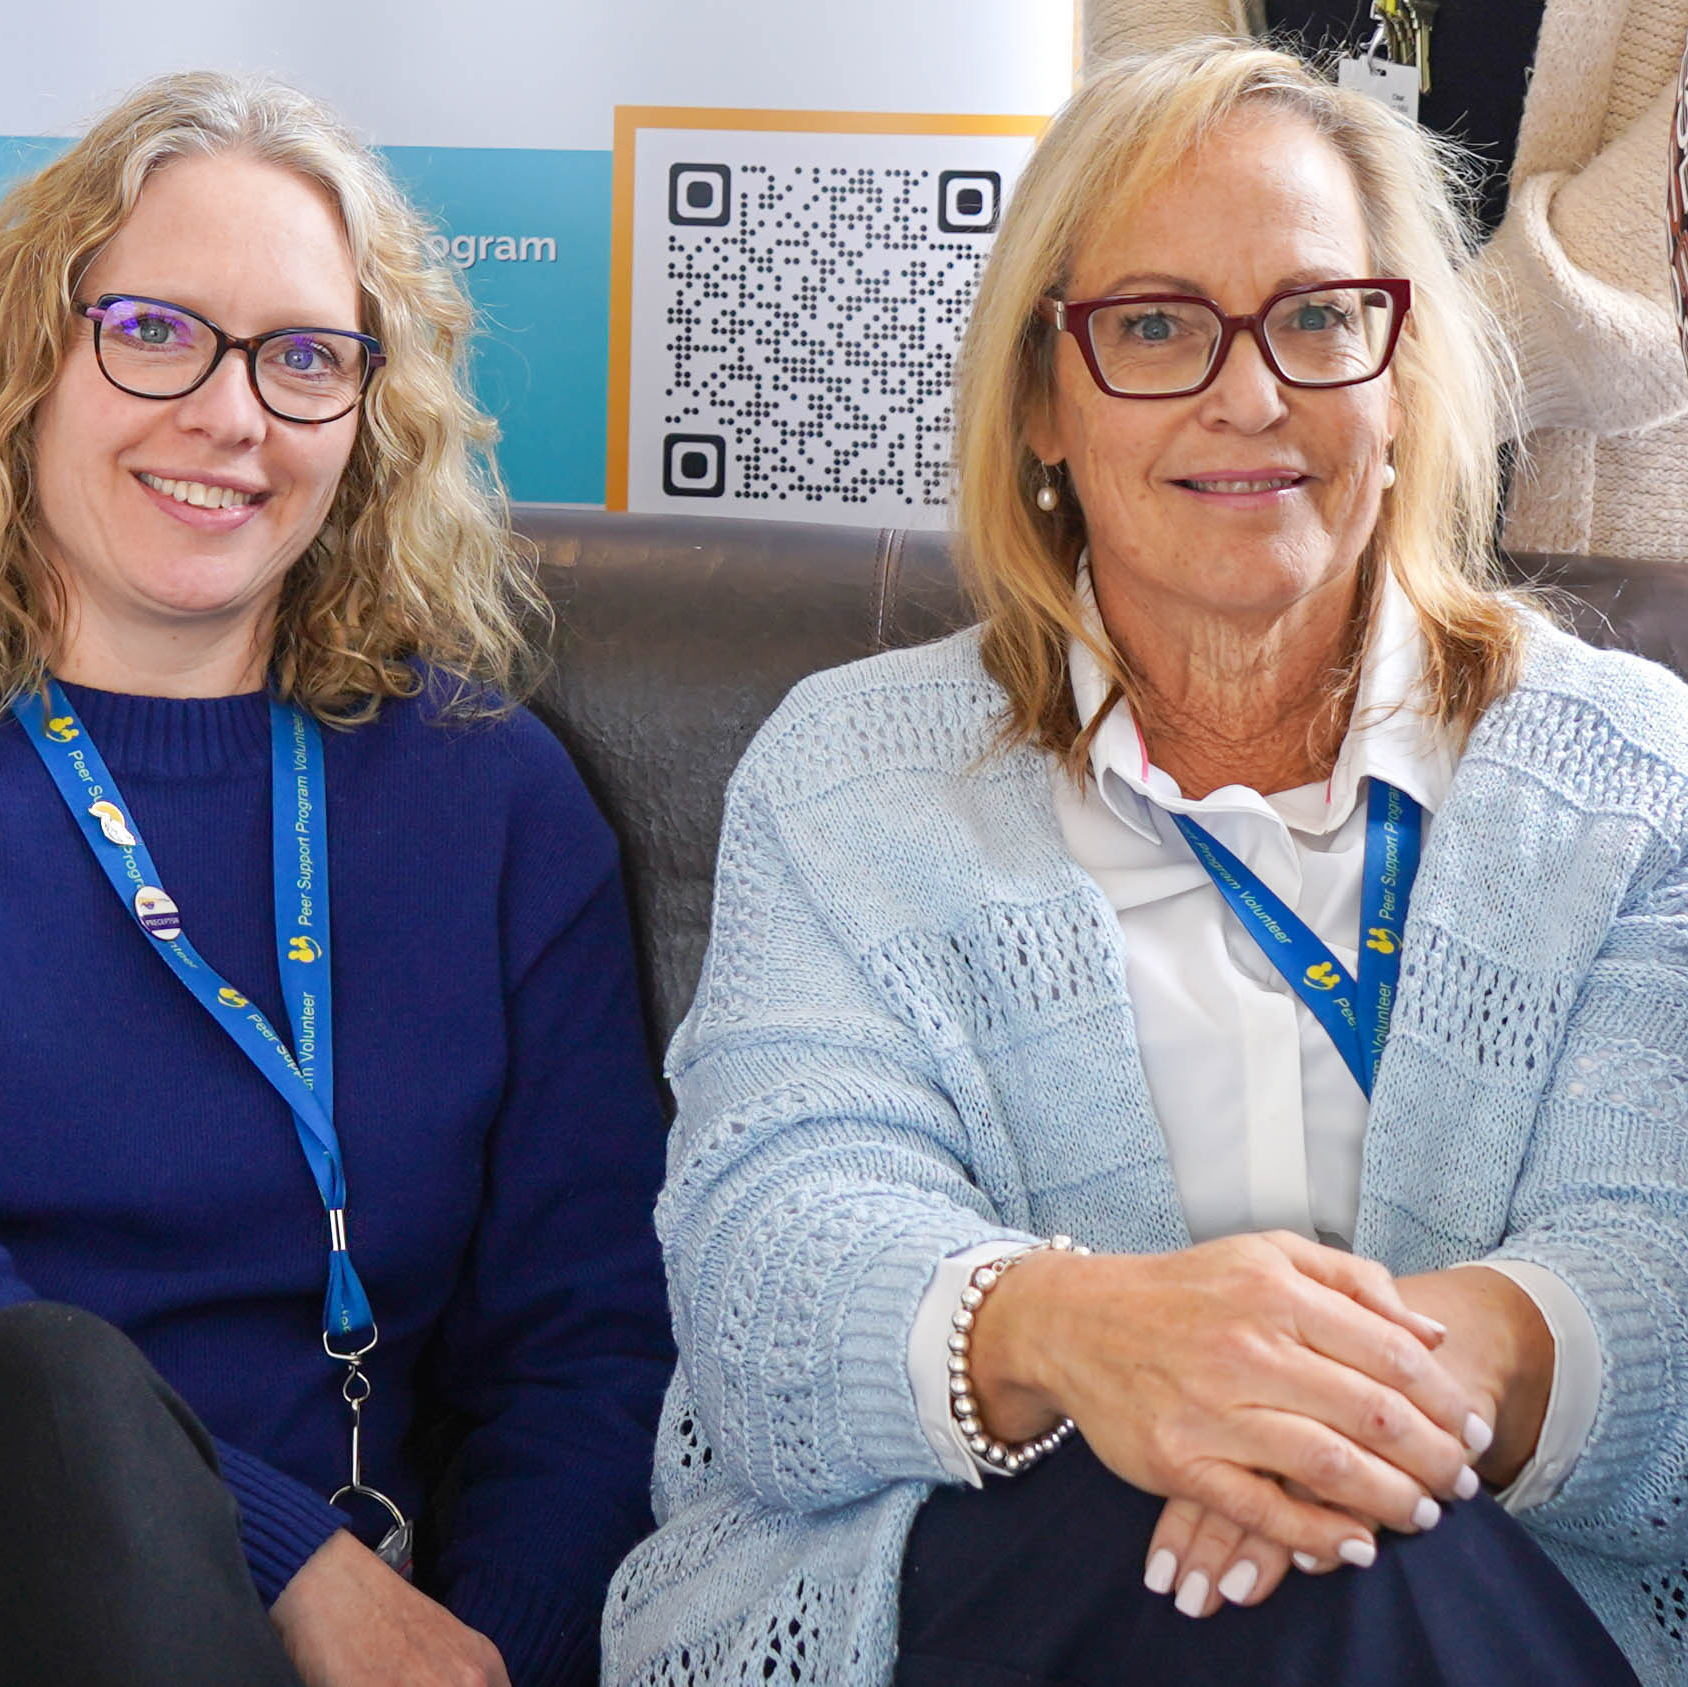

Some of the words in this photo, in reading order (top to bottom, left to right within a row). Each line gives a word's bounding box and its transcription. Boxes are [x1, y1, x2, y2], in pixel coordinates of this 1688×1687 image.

[426, 233, 557, 269] ogram
[68, 750, 94, 782] Peer
[293, 714, 309, 771] Volunteer
[295, 776, 312, 833] Program
[1384, 786, 1403, 834] Progra
[297, 836, 314, 890] Support
[1381, 836, 1400, 887] Support
[298, 894, 313, 926] Peer
[1195, 840, 1241, 890] Program
[1239, 890, 1293, 944] Volunteer
[1379, 891, 1396, 921] Peer
[247, 1013, 280, 1042] Peer
[299, 992, 315, 1063] Volunteer
[1333, 997, 1356, 1030] Pee
[1371, 982, 1392, 1053] Volunteer
